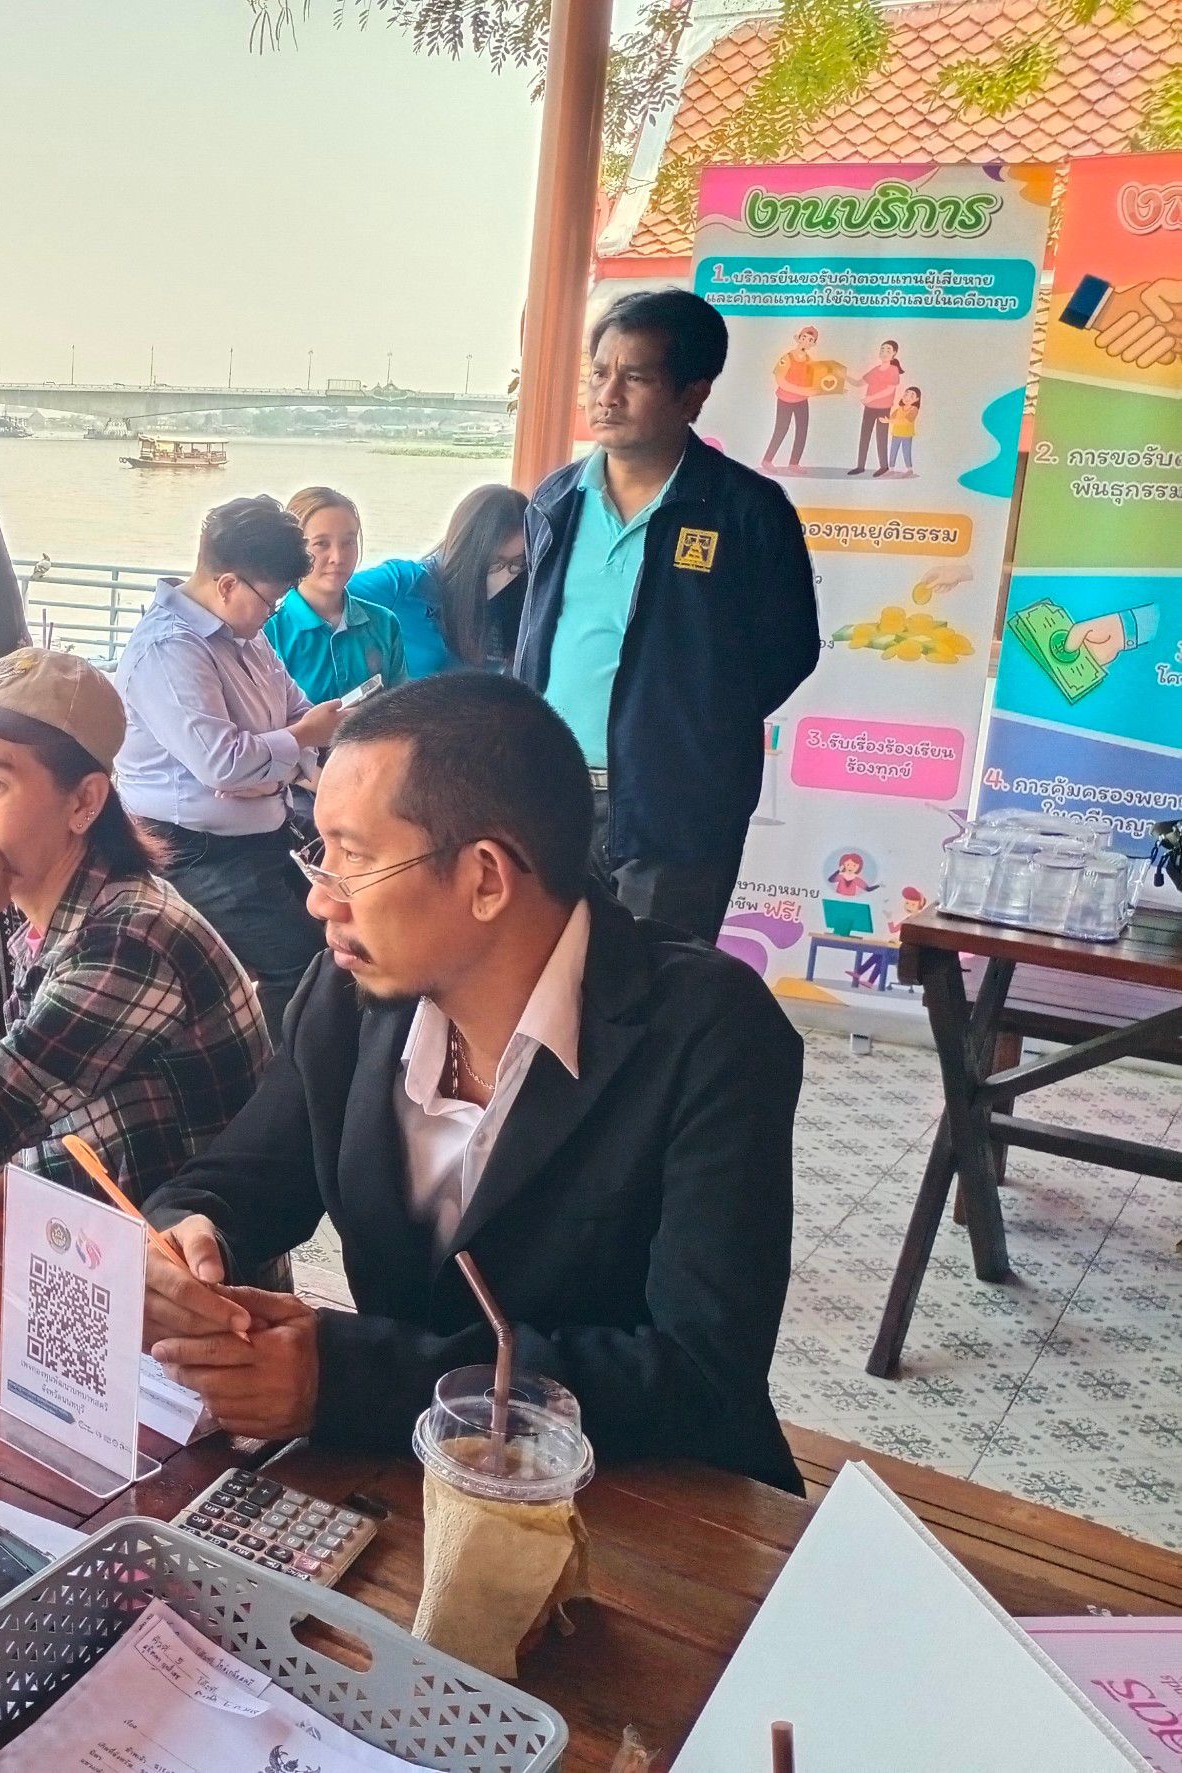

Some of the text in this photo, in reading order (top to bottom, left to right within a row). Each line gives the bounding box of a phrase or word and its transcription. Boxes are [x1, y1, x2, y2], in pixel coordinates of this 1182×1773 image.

[745, 180, 998, 236] งานบริการ
[733, 267, 993, 290] บริการยื่นขอรับค่าตอบแทนผู้เสียหาย
[706, 288, 1018, 312] และค่าทดแทนค่าใช้จ่ายแก่จำเลยในคดีอาญา
[1035, 441, 1059, 463] 2.
[807, 730, 955, 760] 3. รับเรื่องร้องเรียน
[847, 757, 912, 781] ร้องทุกข์
[983, 768, 1010, 792] 4.
[763, 900, 802, 924] ฟรี!
